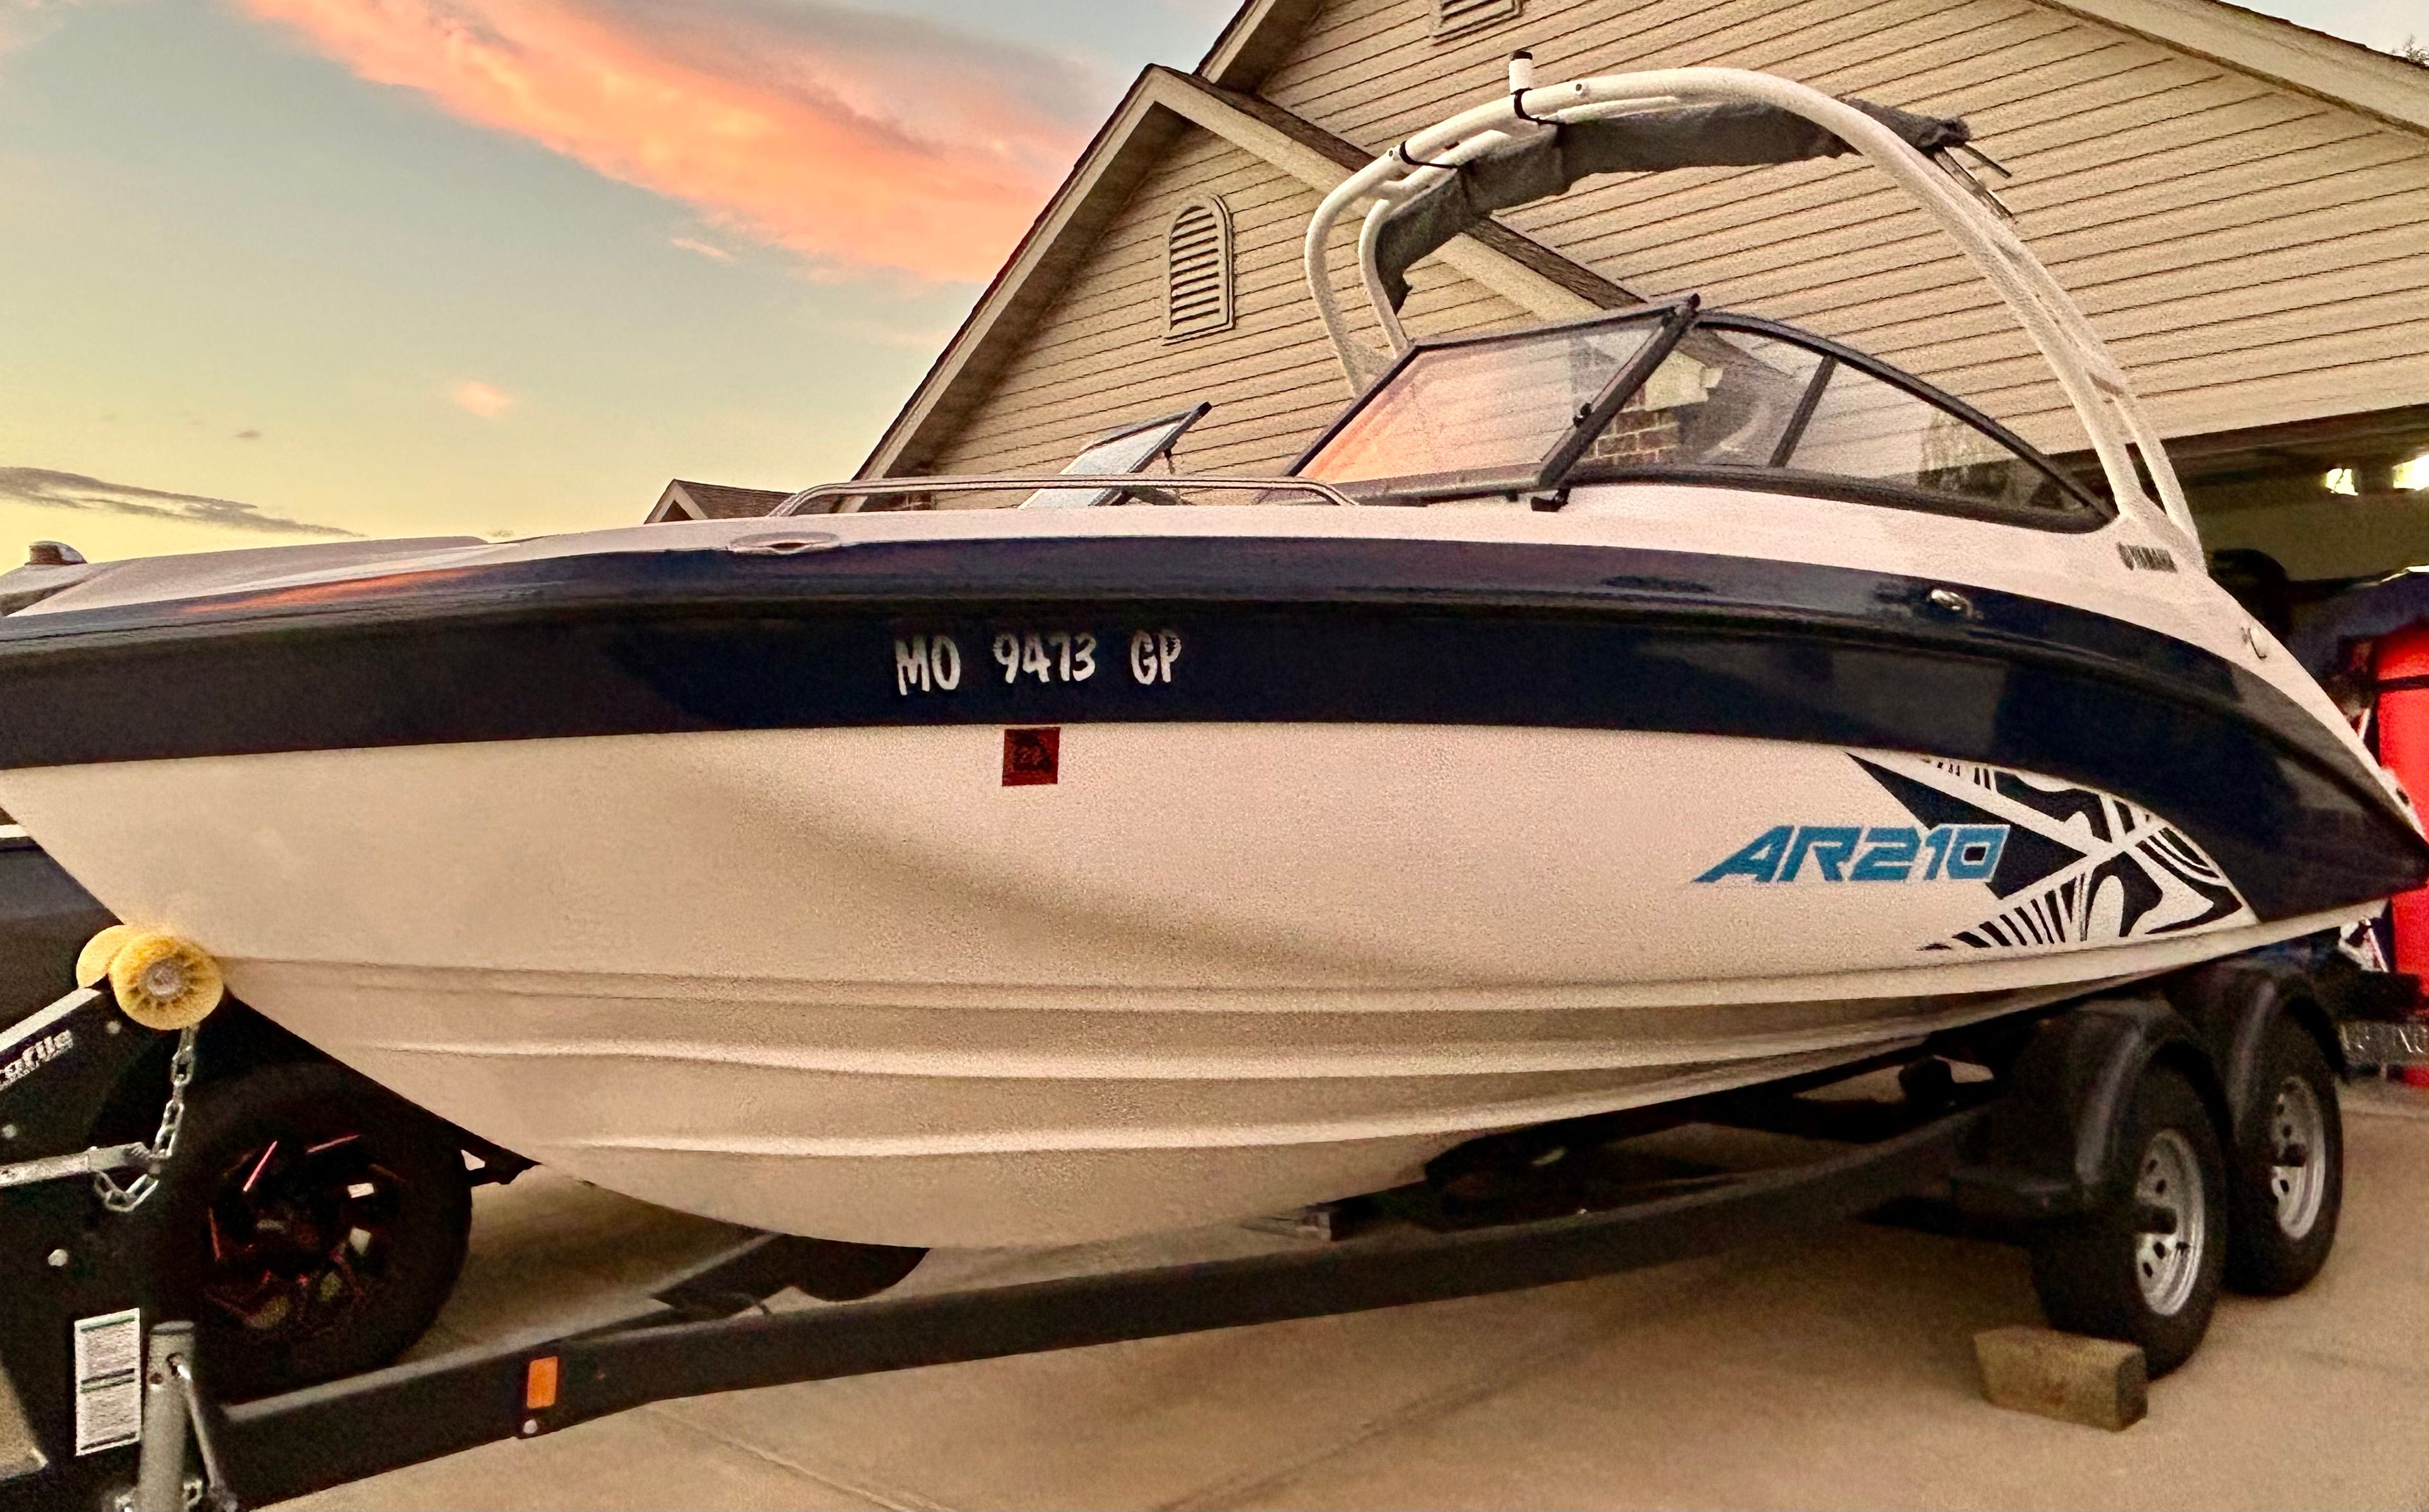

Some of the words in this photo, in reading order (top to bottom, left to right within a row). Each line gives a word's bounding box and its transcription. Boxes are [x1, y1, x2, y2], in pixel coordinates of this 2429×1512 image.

[895, 634, 961, 696] MO
[993, 632, 1098, 683] 9473
[1130, 629, 1182, 684] GP
[1692, 824, 2011, 883] AR210
